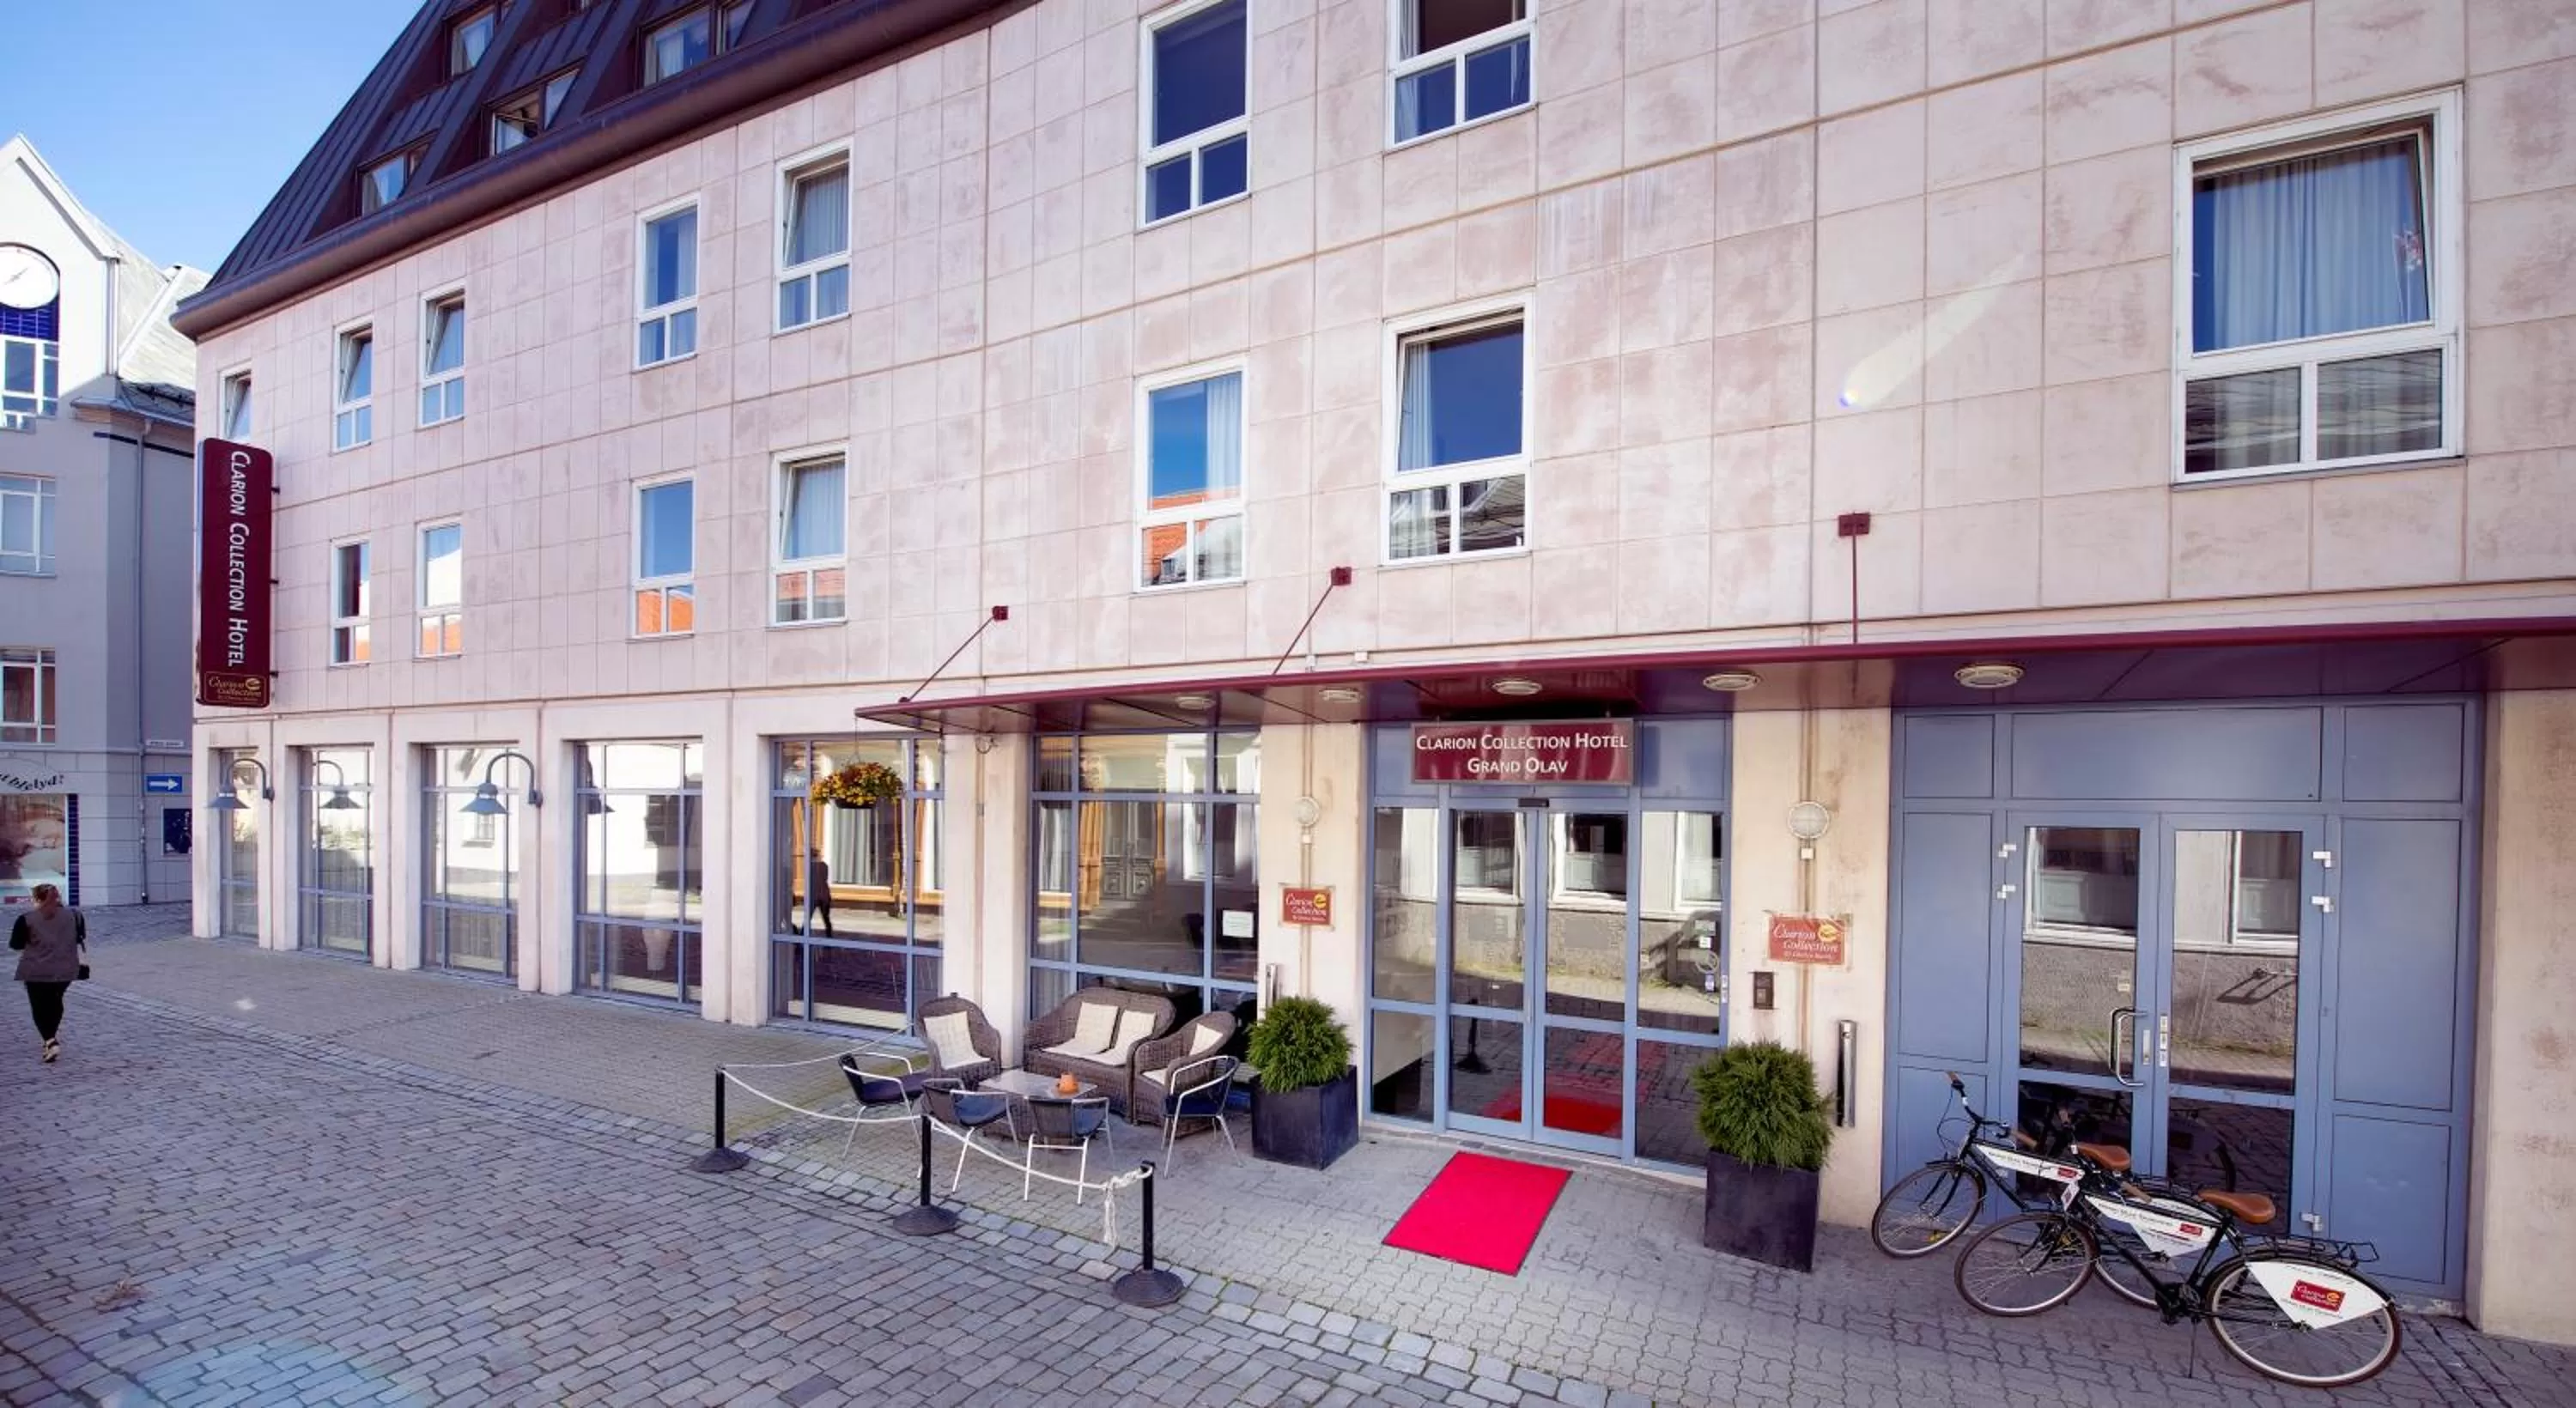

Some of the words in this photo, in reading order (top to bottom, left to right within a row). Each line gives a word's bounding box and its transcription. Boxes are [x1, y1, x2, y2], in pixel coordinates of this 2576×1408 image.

[230, 451, 250, 515] CLARION
[229, 522, 249, 611] COLLECTION
[228, 617, 248, 667] HOTEL
[1416, 735, 1477, 750] CLARION
[1480, 734, 1571, 750] COLLECTION
[1575, 732, 1628, 749] HOTEL
[1467, 756, 1521, 774] GRAND
[1525, 756, 1569, 774] OLAV
